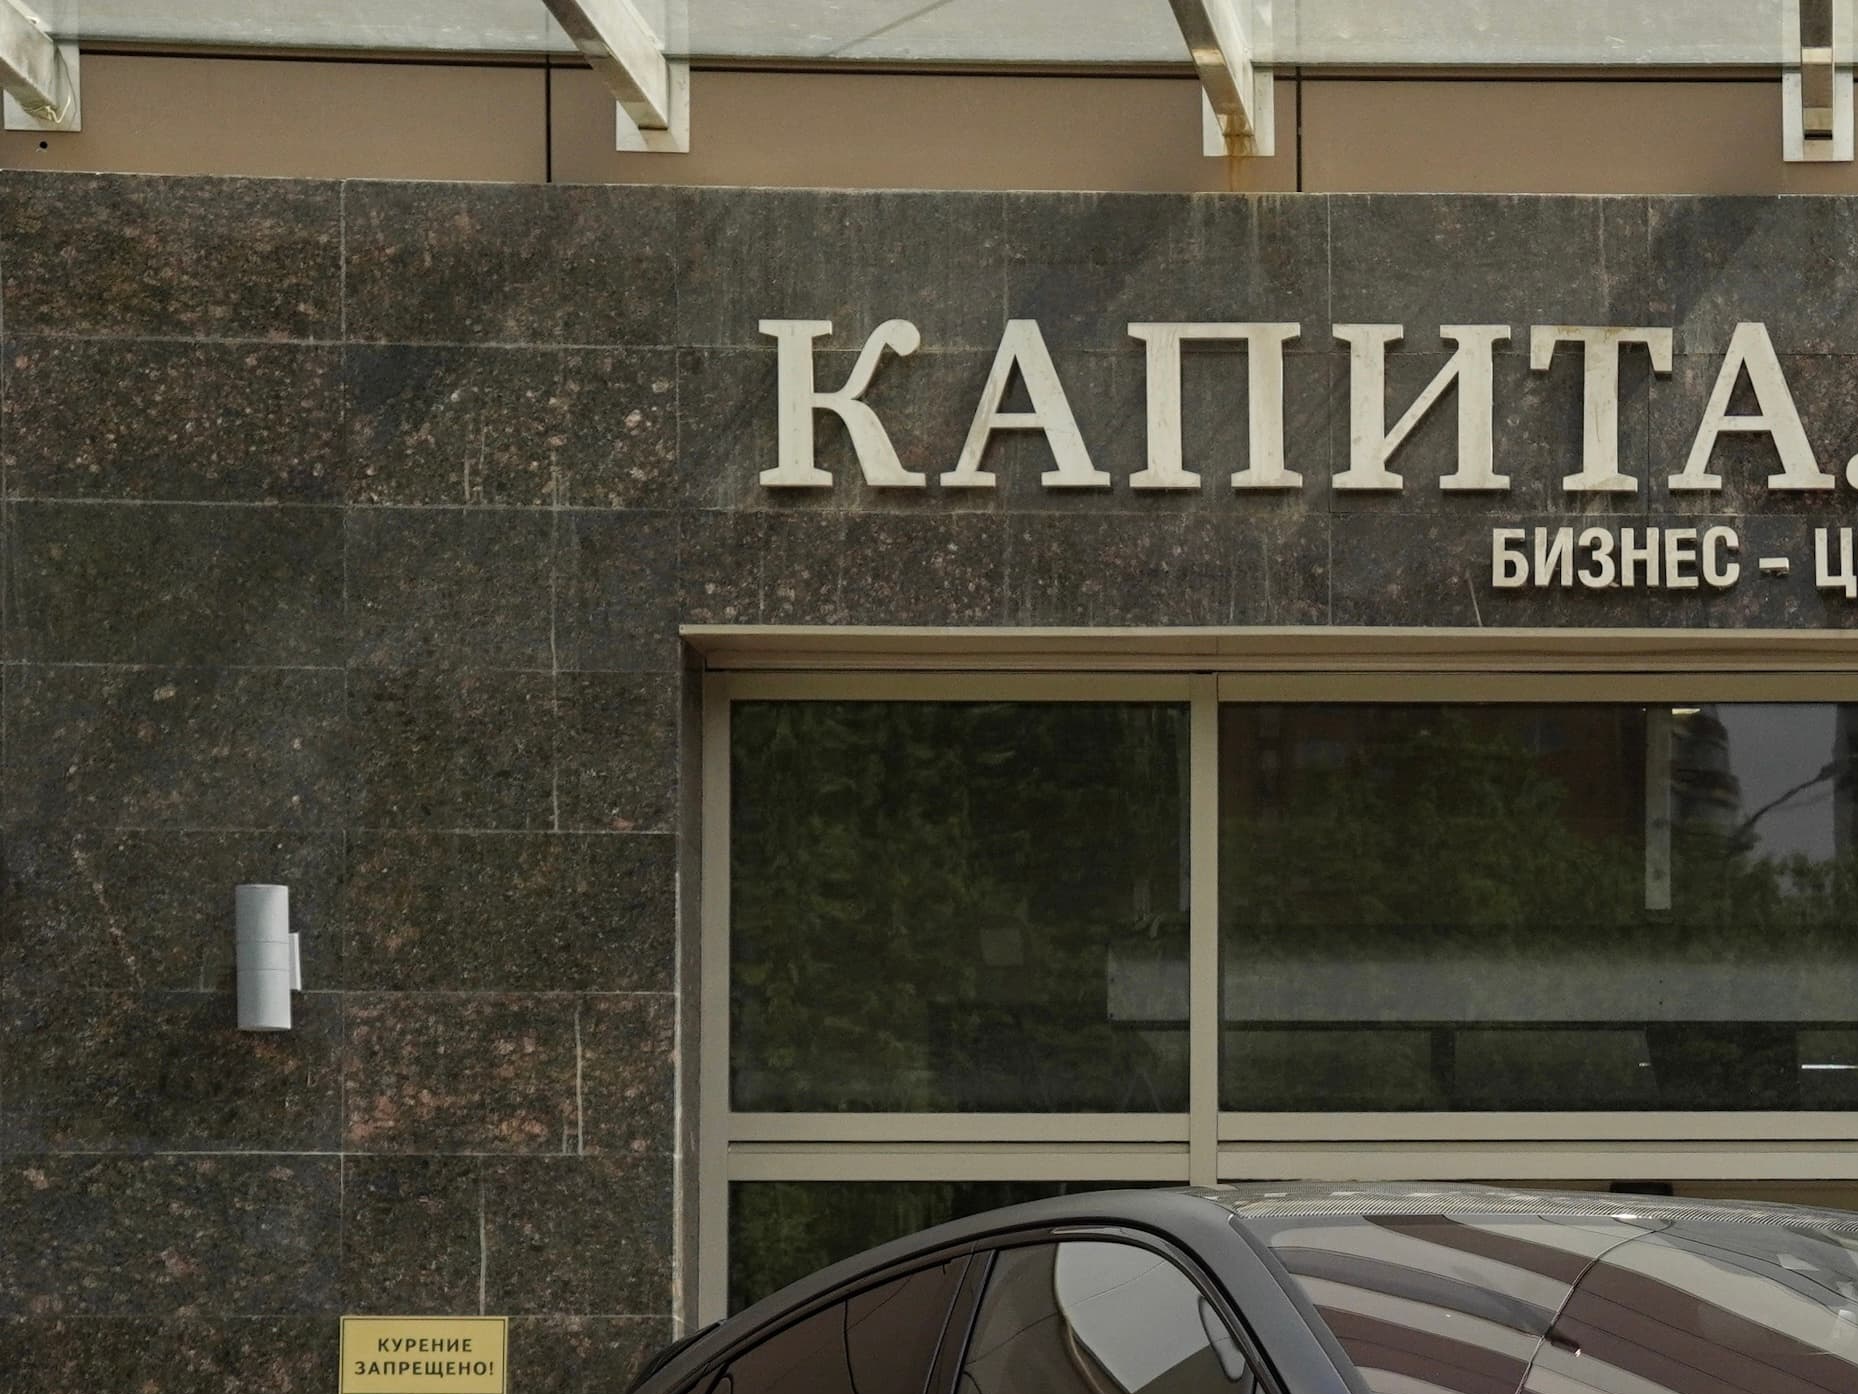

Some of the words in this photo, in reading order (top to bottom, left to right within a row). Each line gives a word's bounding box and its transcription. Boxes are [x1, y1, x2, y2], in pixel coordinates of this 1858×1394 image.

[1492, 525, 1741, 590] БИЗНЕС
[377, 1338, 473, 1353] КУРЕНИЕ
[354, 1361, 494, 1378] ЗАПРЕЩЕНО!
